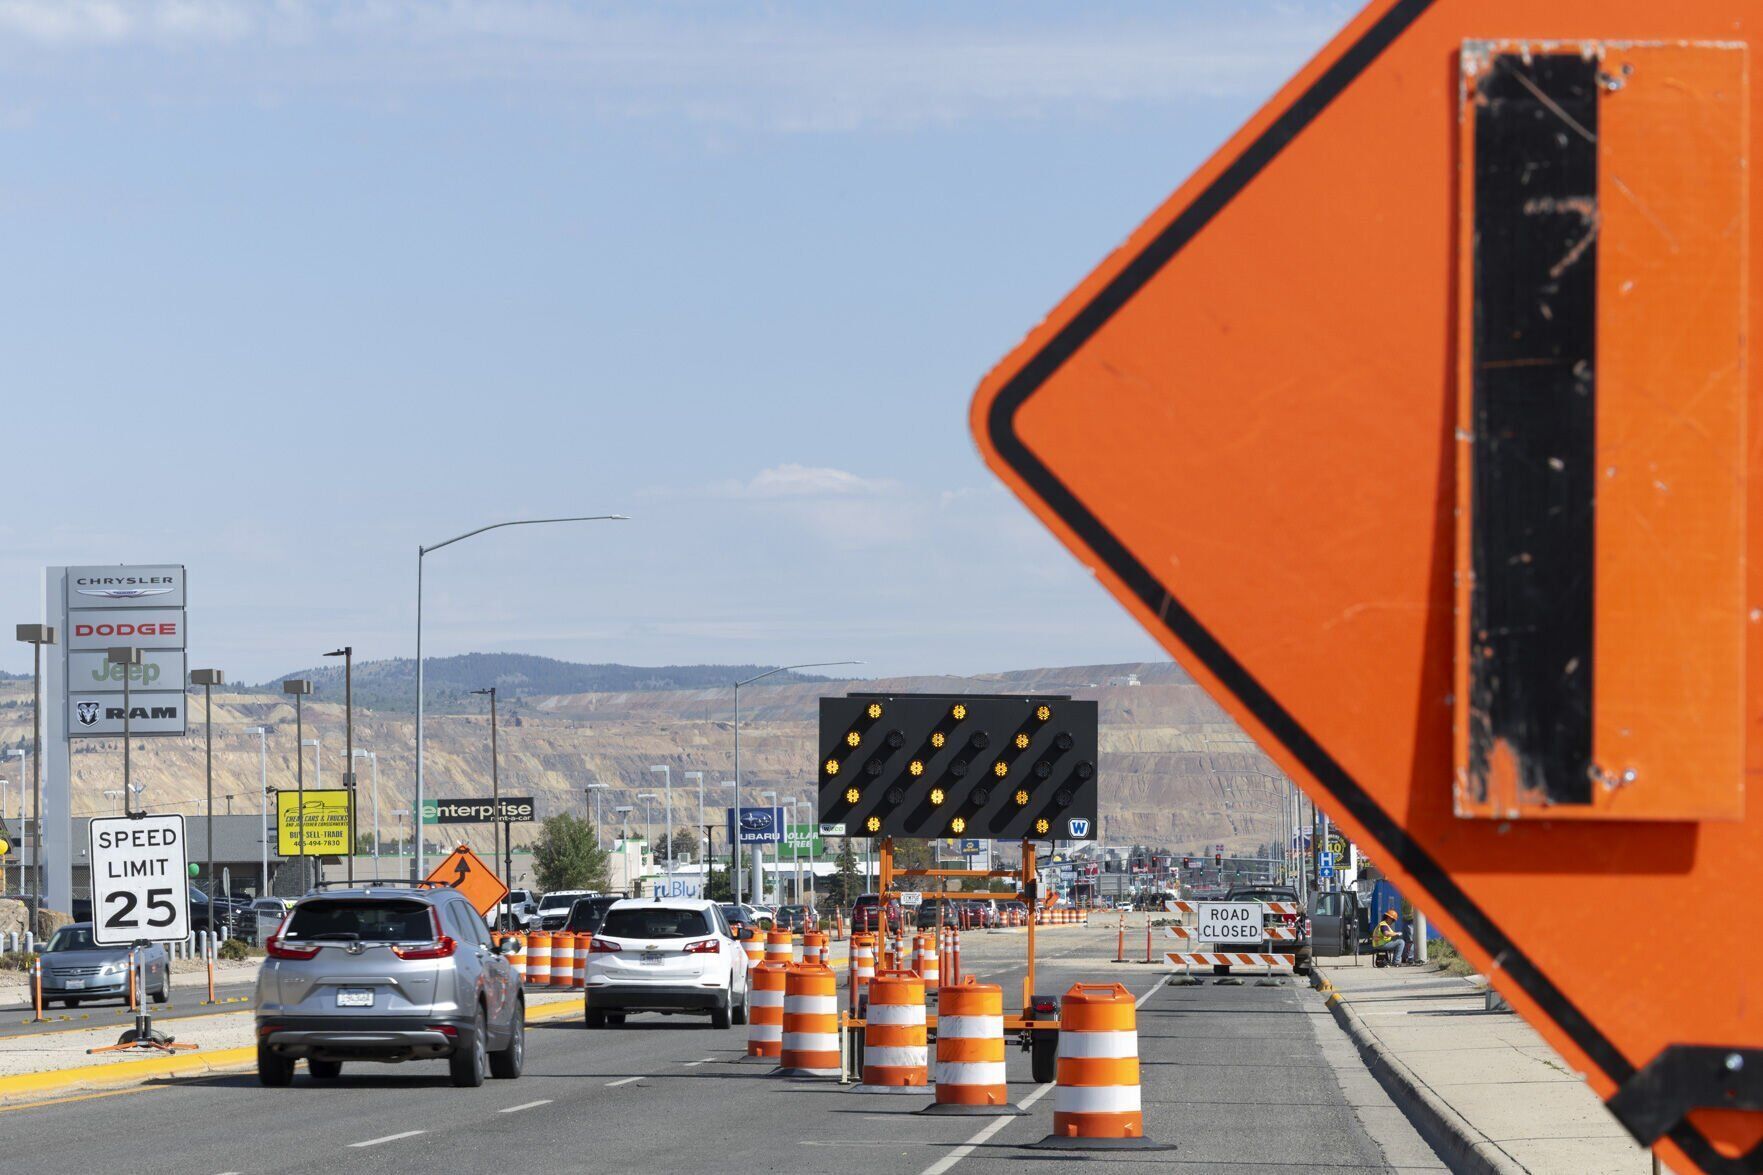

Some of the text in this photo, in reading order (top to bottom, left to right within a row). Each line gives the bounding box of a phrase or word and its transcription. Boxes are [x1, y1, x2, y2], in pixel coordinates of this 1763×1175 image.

[77, 577, 173, 585] CHRYSLER
[75, 623, 176, 636] DODGE
[105, 707, 177, 719] RAM
[99, 829, 176, 848] SPEED
[786, 832, 819, 840] OLLAR
[1320, 852, 1332, 866] H
[108, 859, 168, 878] LIMIT
[105, 888, 176, 928] 25
[1211, 909, 1249, 920] ROAD
[1203, 925, 1258, 937] CLOSED
